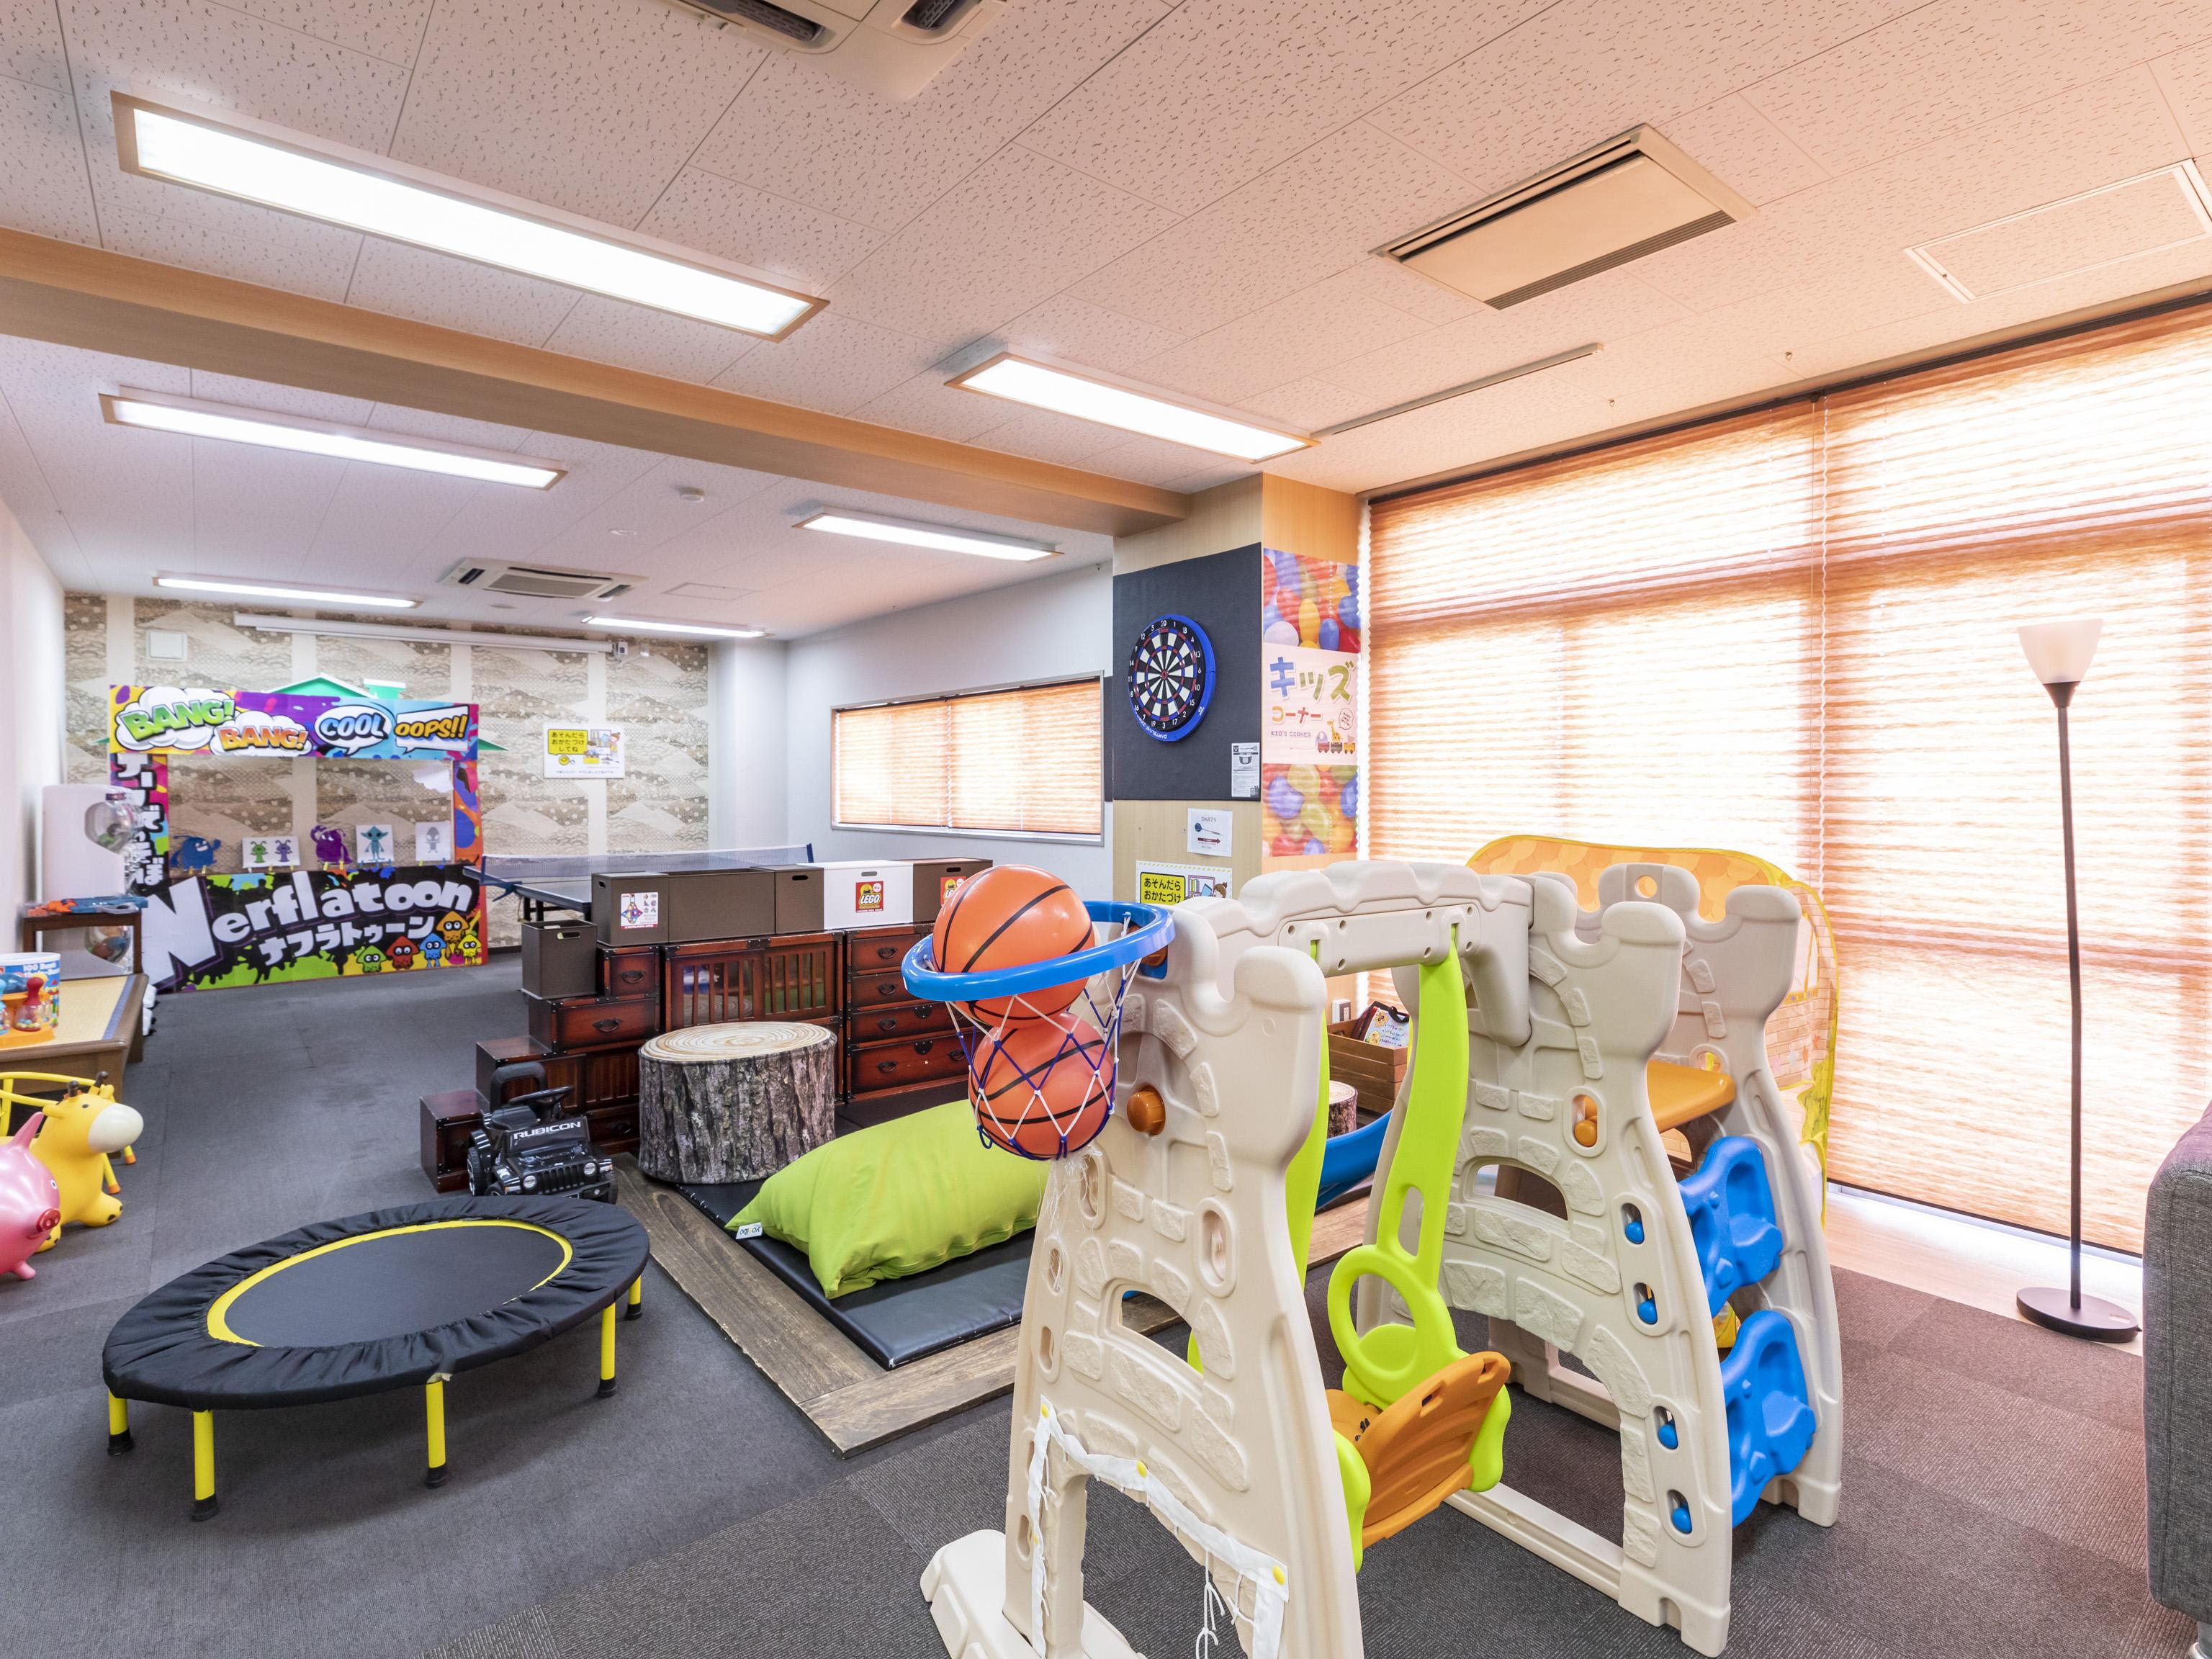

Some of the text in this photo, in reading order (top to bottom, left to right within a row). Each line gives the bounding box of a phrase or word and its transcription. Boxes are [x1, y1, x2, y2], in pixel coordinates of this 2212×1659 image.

[1269, 656, 1355, 701] キッズ
[119, 699, 235, 742] BANG!
[319, 712, 389, 741] COOL
[394, 714, 469, 739] OOPS!!
[1272, 706, 1322, 724] コーナー
[217, 726, 309, 752] BANG!
[1143, 890, 1181, 903] おかたづけ
[1144, 878, 1181, 891] あそんだら
[860, 894, 881, 904] LEGO
[141, 871, 472, 988] Nerflatoon
[258, 916, 435, 966] ナフラトゥーン
[513, 1120, 581, 1140] RUBICON
